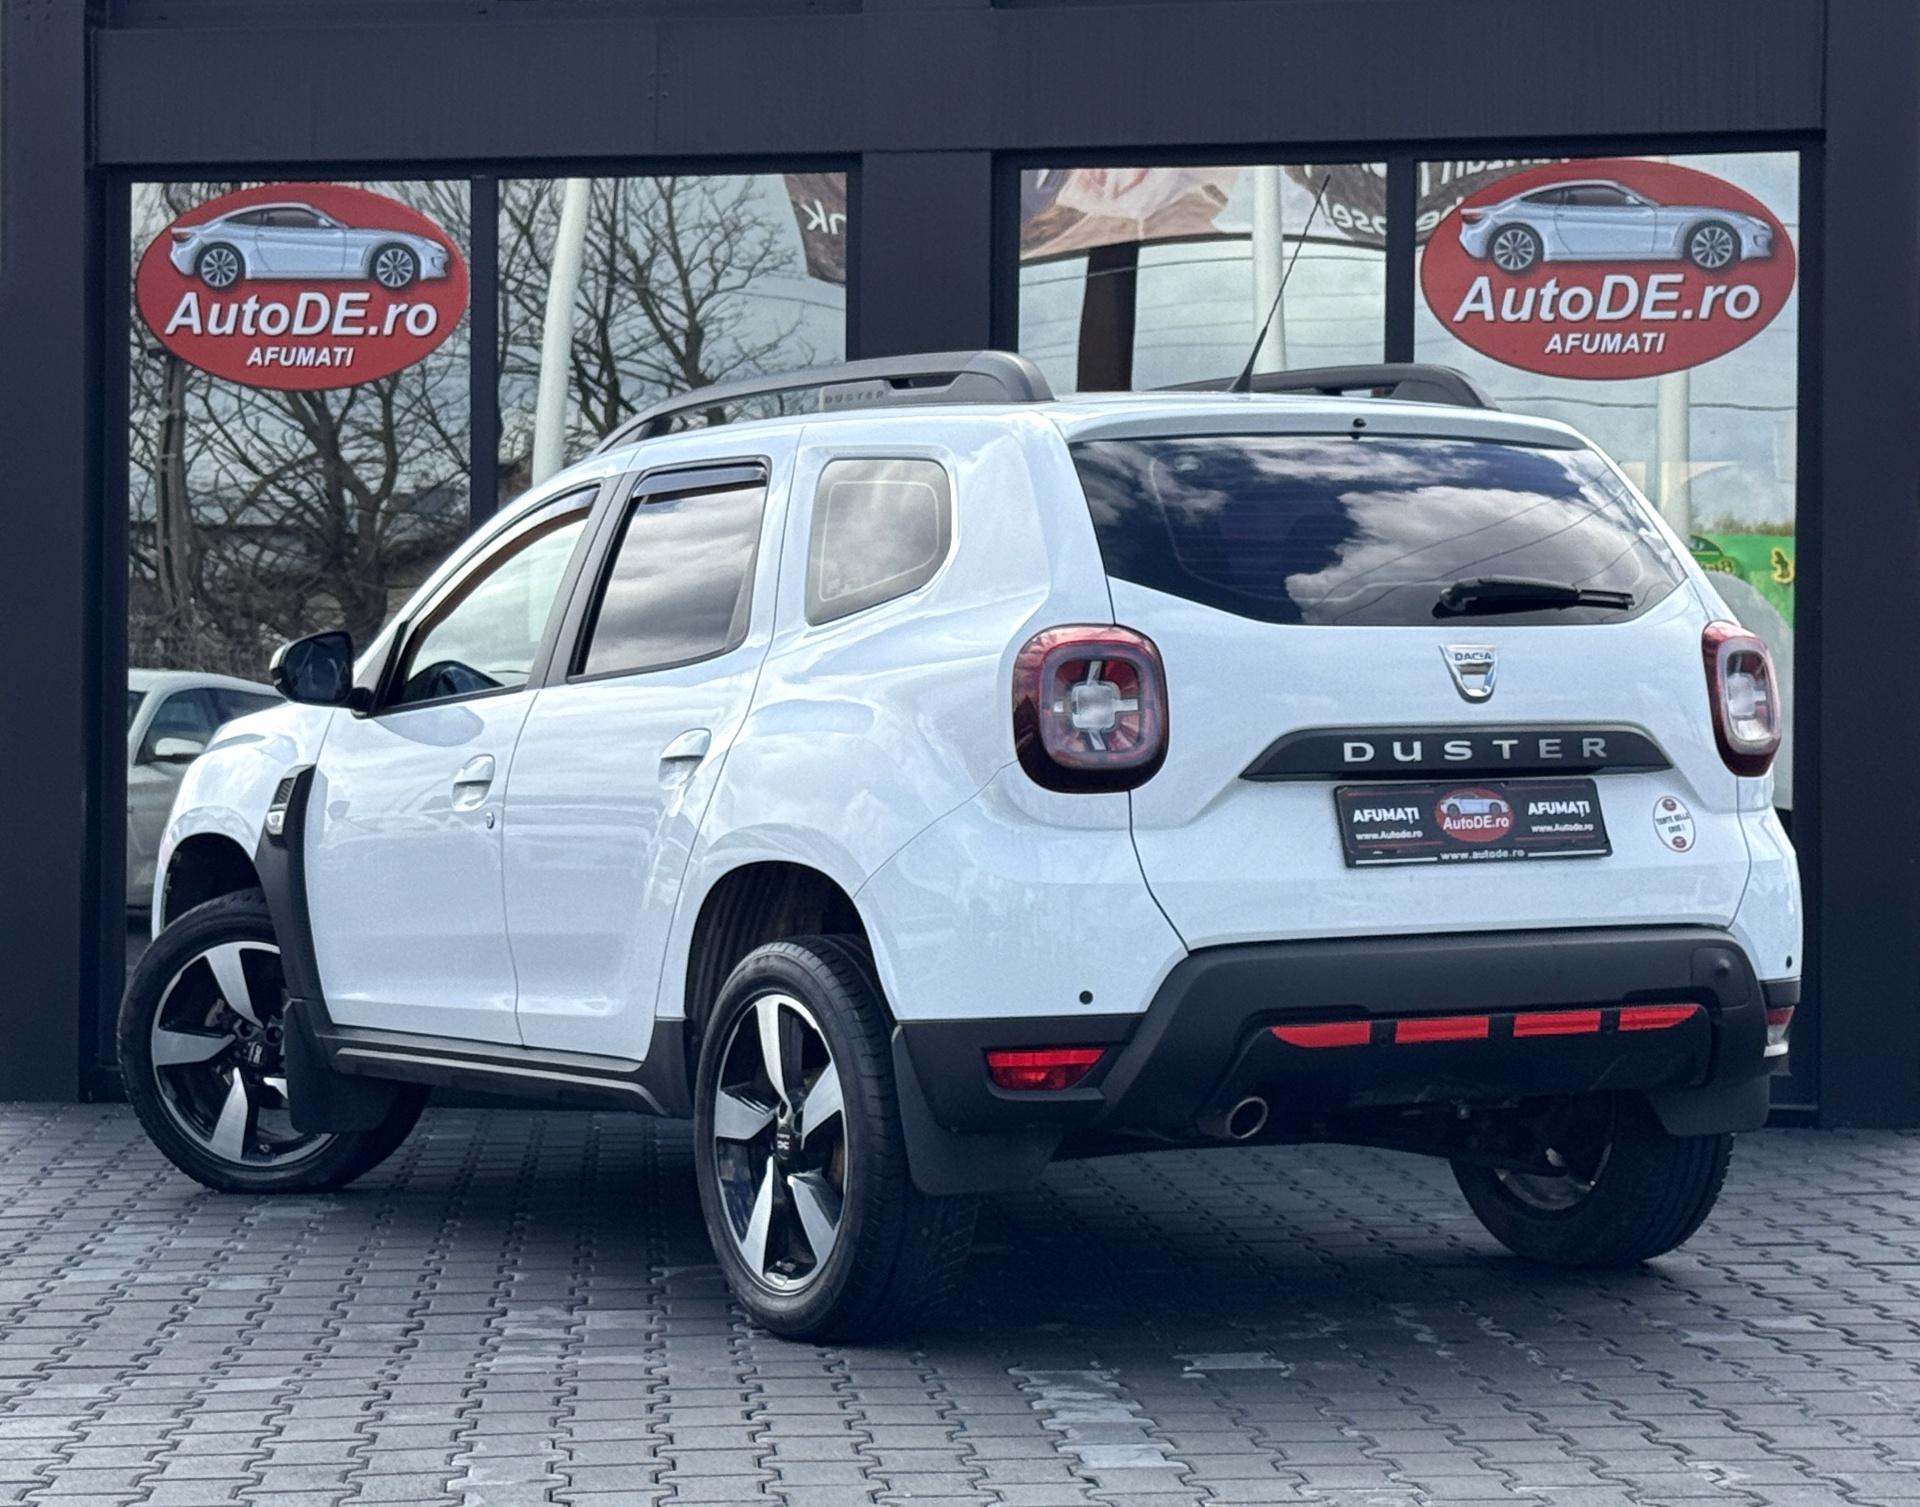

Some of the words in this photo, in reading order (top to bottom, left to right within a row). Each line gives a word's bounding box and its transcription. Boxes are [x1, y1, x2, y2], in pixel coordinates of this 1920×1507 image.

[1453, 273, 1760, 323] AutoDE.ro
[165, 291, 438, 337] AutoDE.ro
[1544, 332, 1666, 355] AFUMATI
[246, 346, 355, 368] AFUMATI
[1454, 651, 1492, 661] DACIA
[1343, 737, 1607, 763] DUSTER
[1442, 814, 1511, 831] AutoDE.ro
[1440, 848, 1526, 861] www.autode.ro
